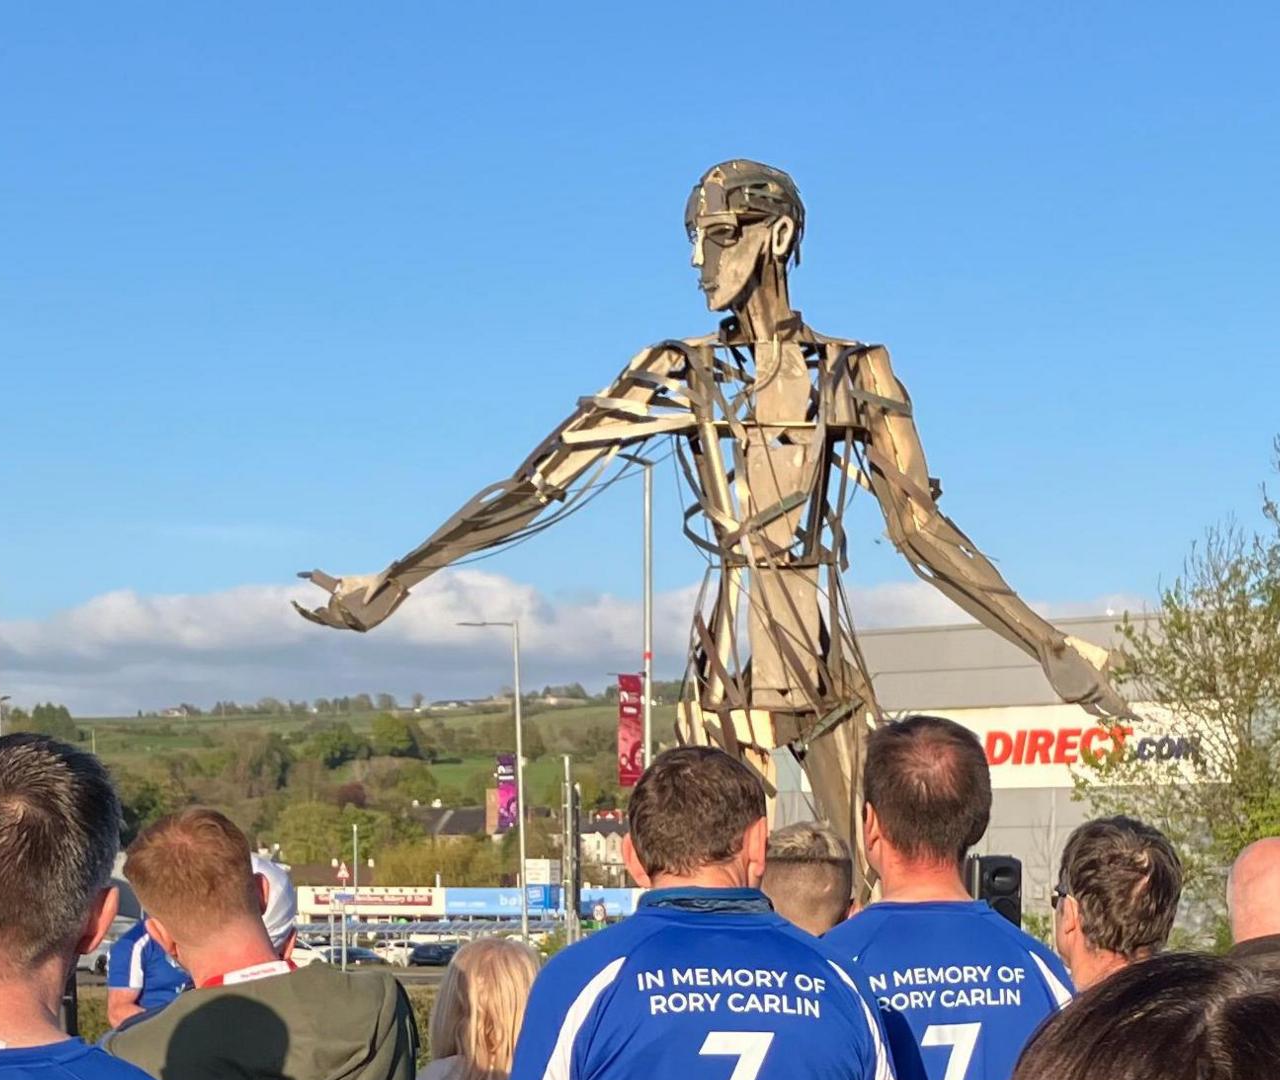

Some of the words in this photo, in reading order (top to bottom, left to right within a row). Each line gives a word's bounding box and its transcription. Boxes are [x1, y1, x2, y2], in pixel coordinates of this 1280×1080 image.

[637, 969, 665, 991] IN
[671, 967, 788, 988] MEMORY
[794, 974, 826, 994] OF
[893, 966, 992, 987] MEMORY
[998, 966, 1025, 983] OF
[650, 993, 721, 1015] RORY
[727, 992, 820, 1019] CARLIN
[940, 988, 1021, 1007] CARLIN
